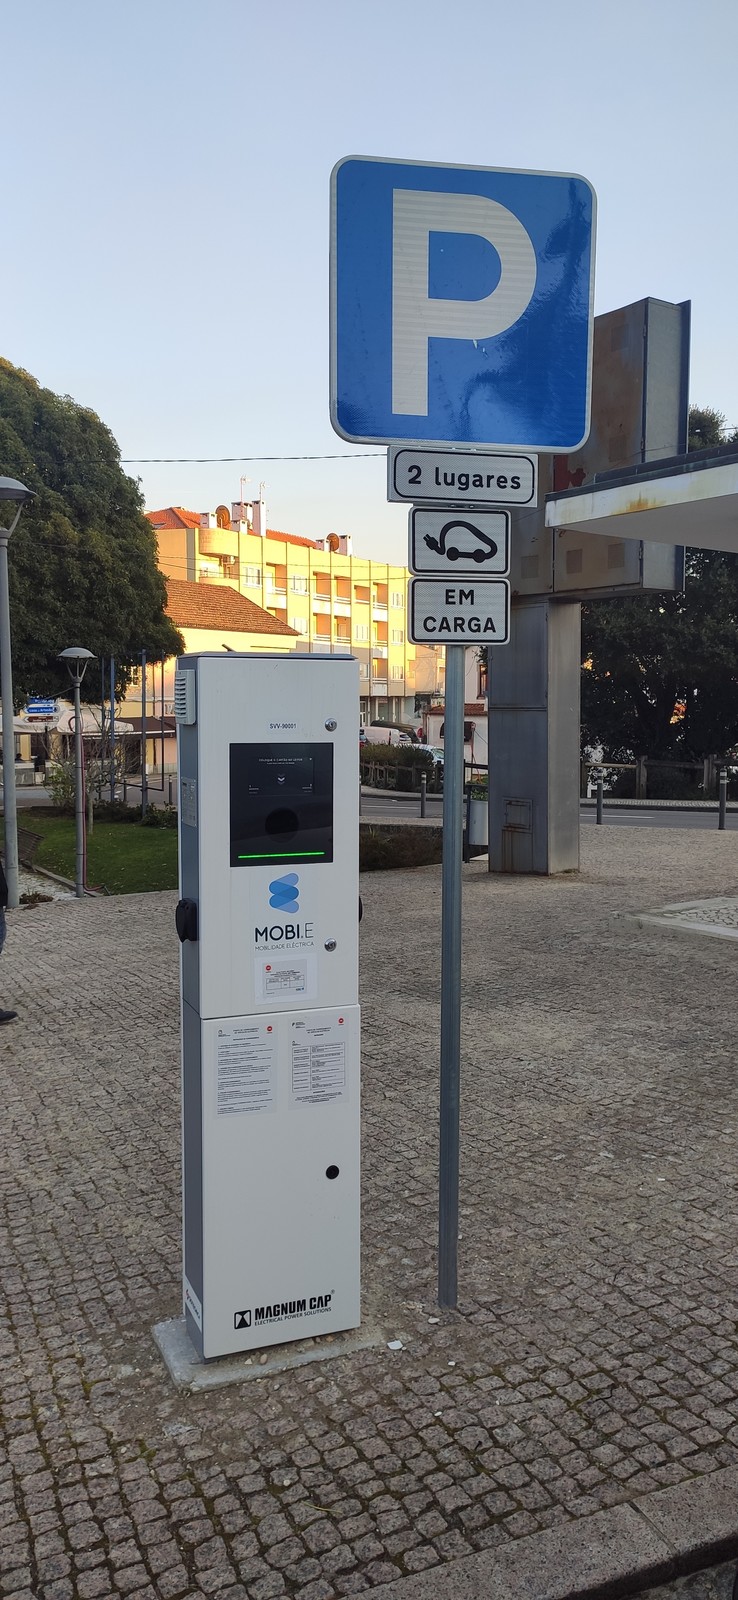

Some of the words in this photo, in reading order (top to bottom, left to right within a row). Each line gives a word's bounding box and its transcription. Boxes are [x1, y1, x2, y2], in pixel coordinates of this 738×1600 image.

[392, 188, 537, 417] P
[407, 465, 422, 485] 2
[434, 467, 521, 491] lugares
[445, 589, 475, 606] EM
[423, 616, 497, 633] CARGA
[254, 922, 314, 943] MOBI.E
[254, 943, 285, 951] MOBILIDADE
[286, 941, 315, 949] ELÉCTRICA
[254, 1299, 307, 1321] MAGNUM
[309, 1294, 332, 1310] CAP
[254, 1317, 284, 1327] ELECTRICAL
[284, 1312, 303, 1321] POWER
[303, 1306, 332, 1317] SOLUTIONS
